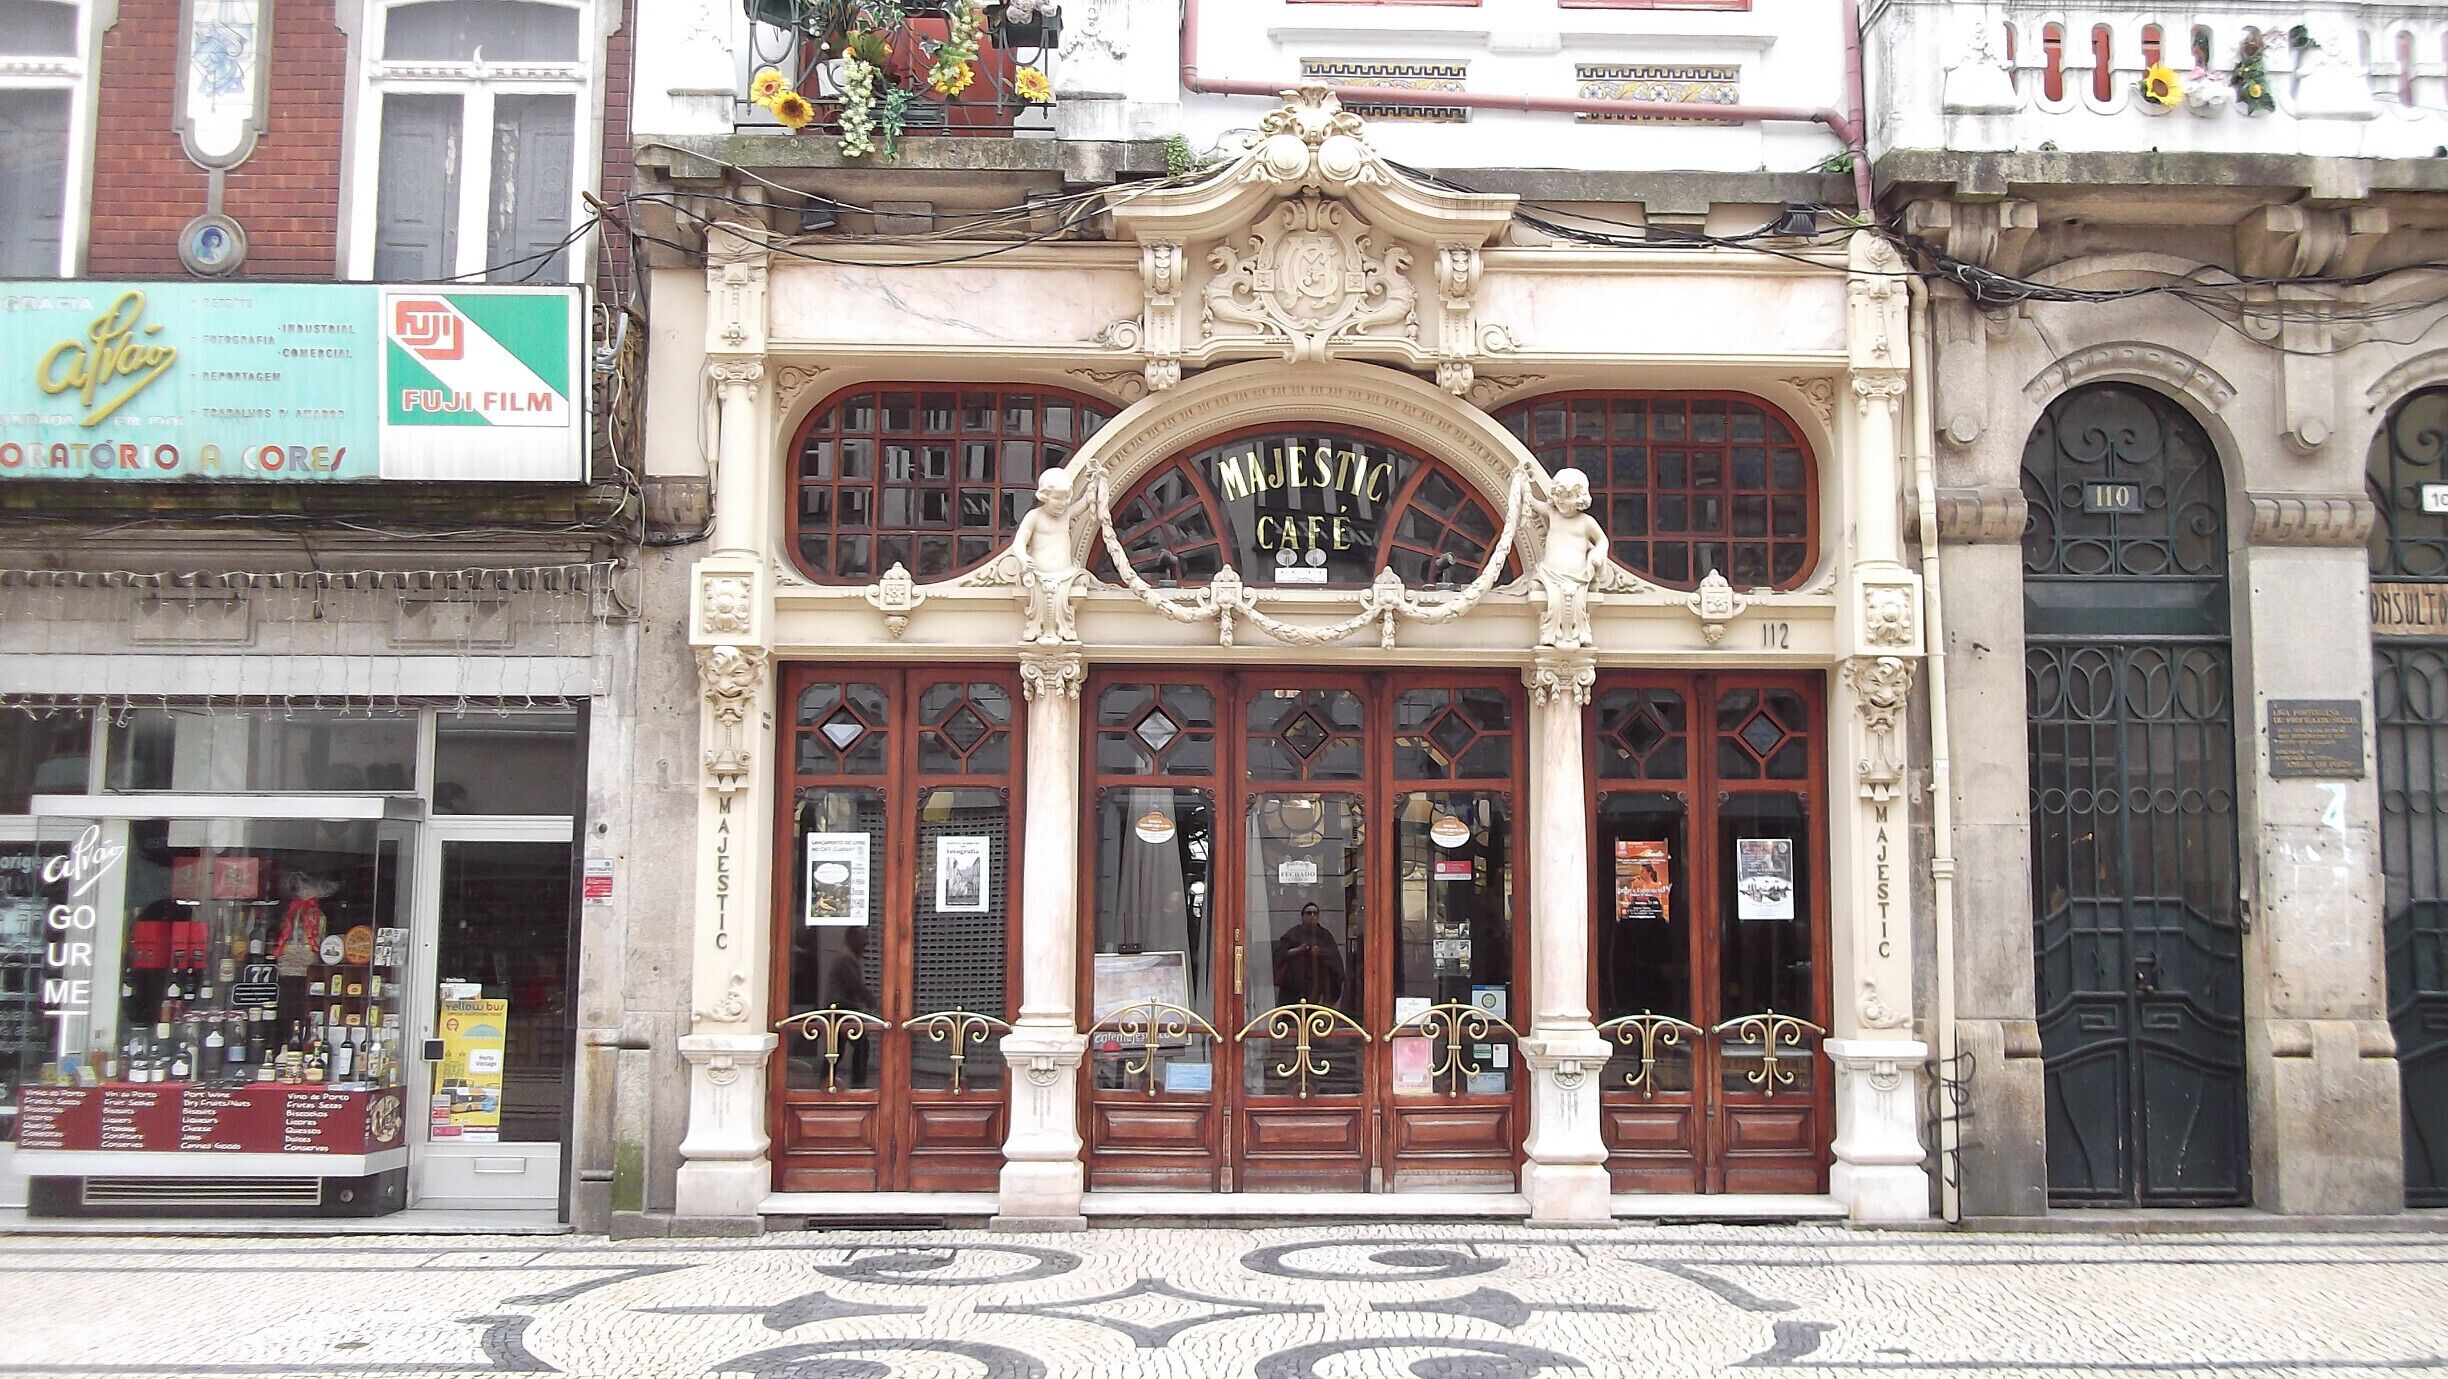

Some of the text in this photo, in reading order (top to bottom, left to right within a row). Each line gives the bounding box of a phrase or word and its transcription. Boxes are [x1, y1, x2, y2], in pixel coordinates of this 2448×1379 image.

[282, 323, 356, 334] INDUSTRIAL
[203, 335, 275, 345] FOTOGRAFIA
[282, 348, 353, 359] COMERCIAL
[202, 371, 281, 382] REPORTAGEM
[402, 388, 555, 413] FUJI FILM
[0, 439, 347, 472] ORATÓRIO A CORES
[1217, 446, 1393, 502] MAJESTIC
[2096, 485, 2130, 507] 110
[1256, 505, 1352, 550] CAFÉ
[1762, 622, 1789, 649] 112
[716, 796, 732, 950] MAJESTIC
[1876, 805, 1891, 958] MAJESTIC
[251, 966, 273, 983] 77
[486, 1001, 504, 1012] bus
[183, 1090, 204, 1098] Port
[322, 1093, 350, 1101] Porto
[184, 1099, 198, 1107] Dry
[318, 1101, 343, 1109] Secas
[214, 1142, 242, 1150] Goods
[284, 1144, 329, 1152] Conservas
